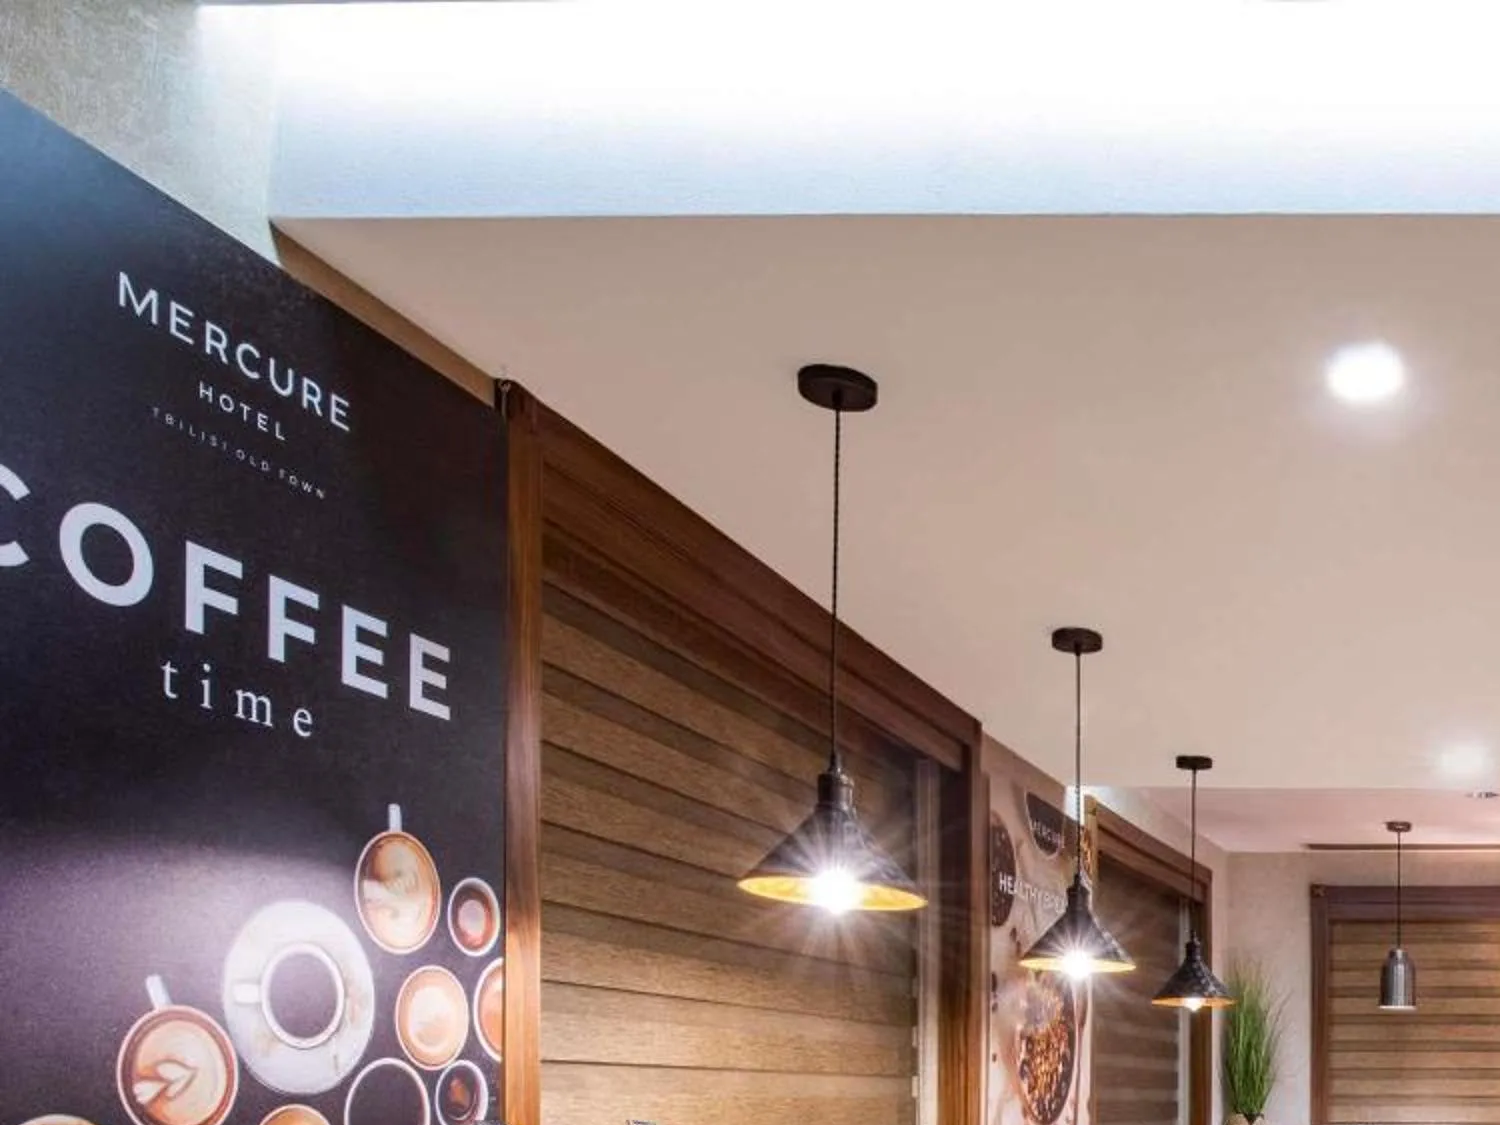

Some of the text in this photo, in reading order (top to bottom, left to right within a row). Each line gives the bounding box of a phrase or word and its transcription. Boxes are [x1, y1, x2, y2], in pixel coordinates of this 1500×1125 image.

[118, 271, 351, 433] MERCURE
[199, 380, 286, 442] HOTEL
[152, 406, 326, 500] TBILISI OLD TOWN
[161, 659, 314, 738] time
[999, 870, 1042, 904] HEALTHY
